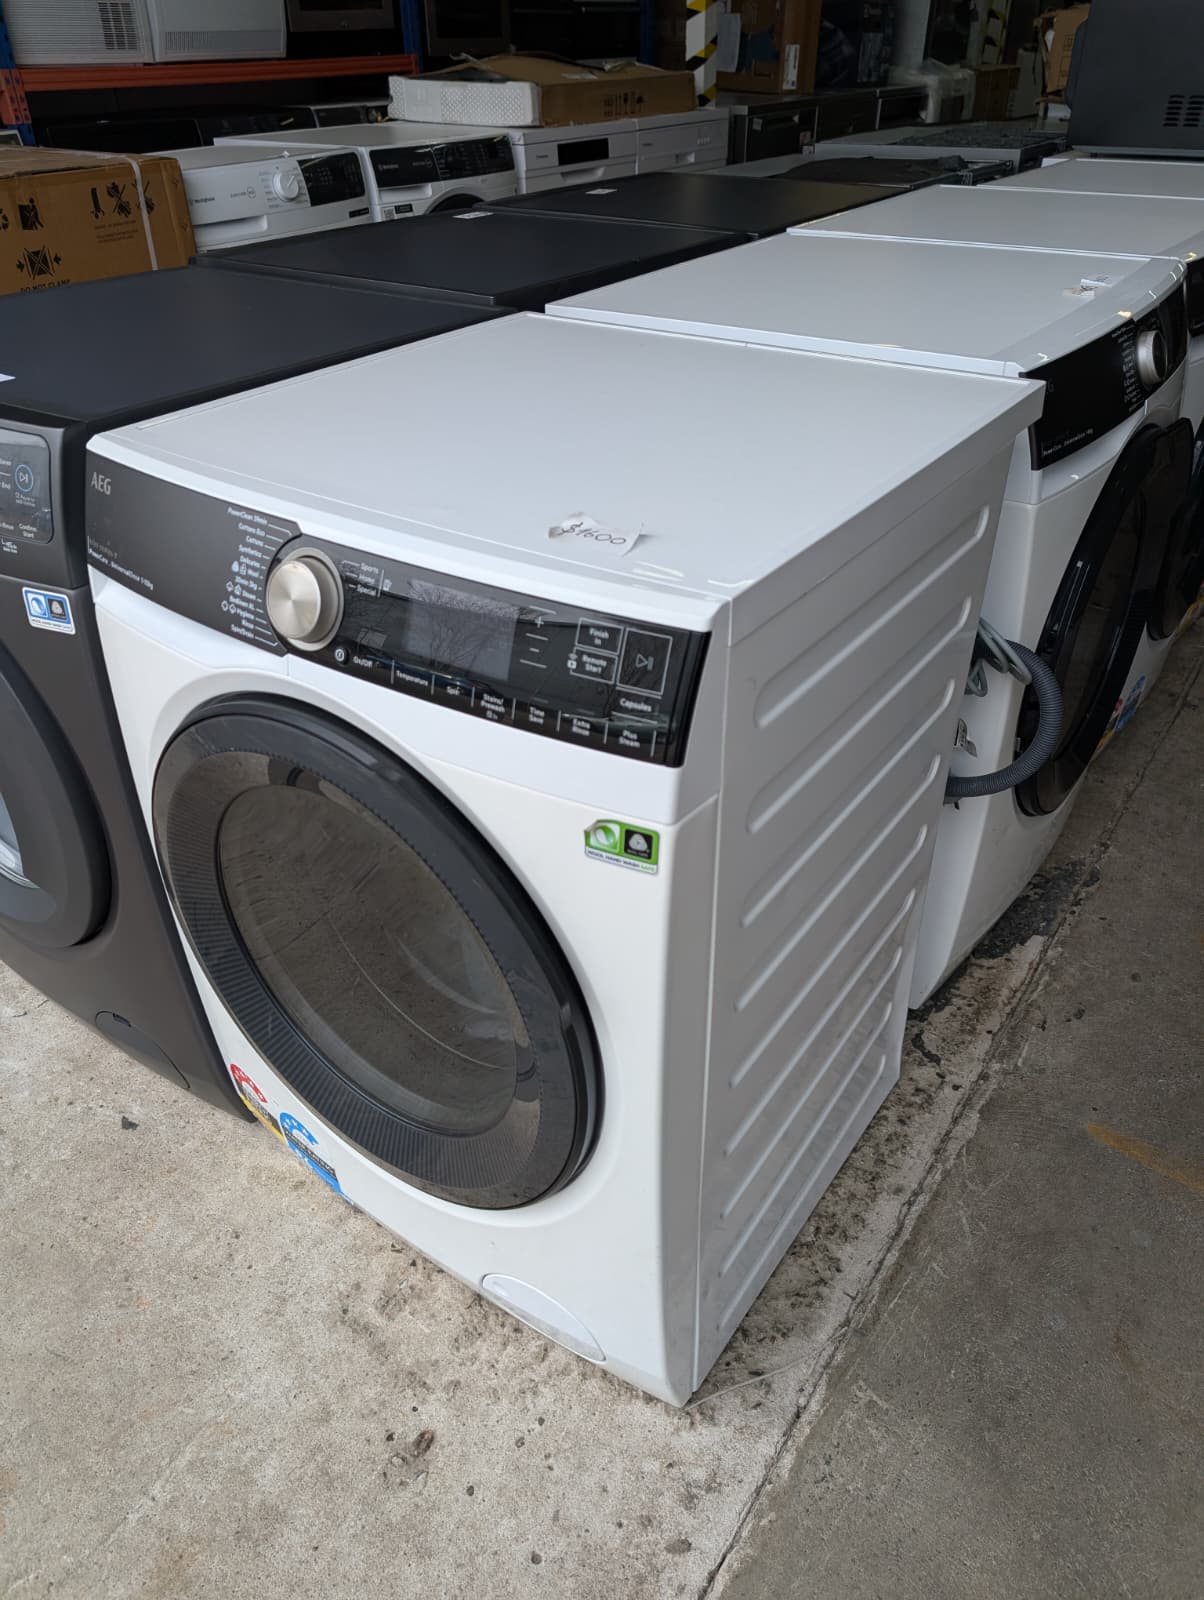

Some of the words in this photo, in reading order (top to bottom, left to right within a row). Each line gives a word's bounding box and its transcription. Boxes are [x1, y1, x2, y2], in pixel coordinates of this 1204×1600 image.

[91, 471, 112, 496] AEG
[557, 521, 627, 545] $1600
[589, 627, 609, 639] Finish
[582, 654, 607, 667] Remote
[585, 663, 602, 674] Start
[396, 670, 429, 687] Temperature
[529, 706, 545, 717] Time
[620, 697, 652, 713] Capsules
[622, 729, 638, 741] Plus
